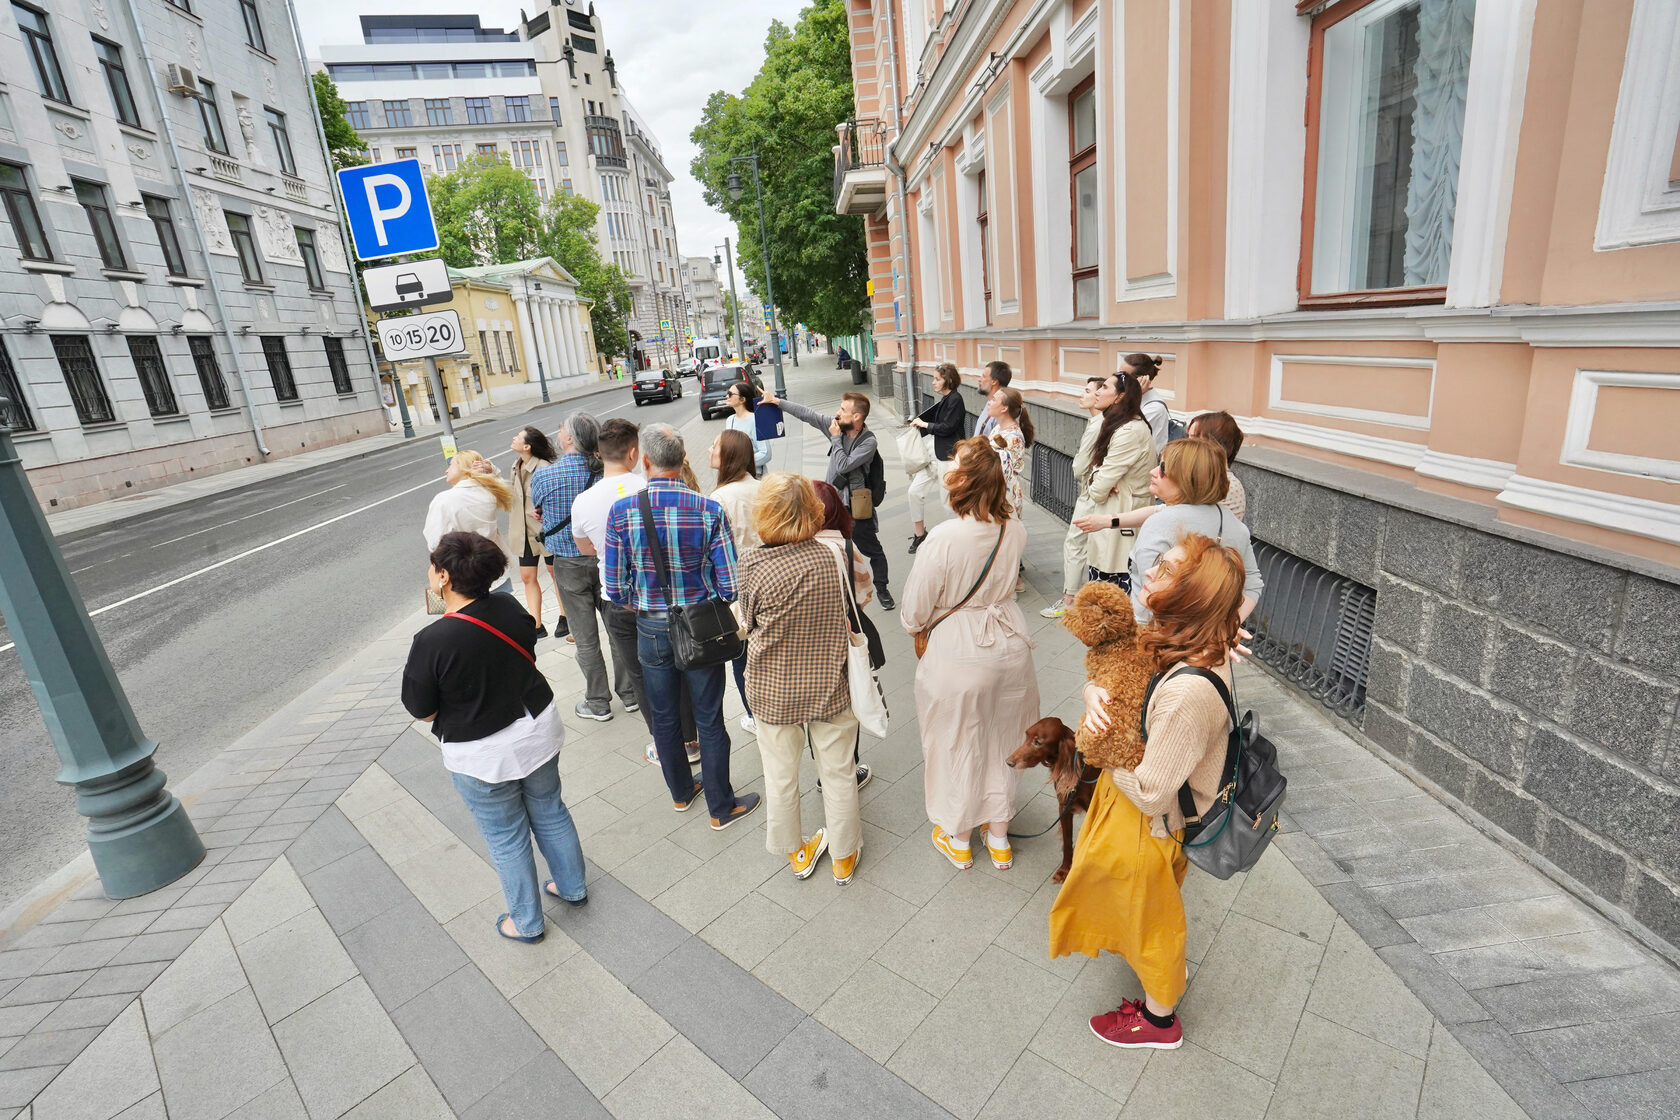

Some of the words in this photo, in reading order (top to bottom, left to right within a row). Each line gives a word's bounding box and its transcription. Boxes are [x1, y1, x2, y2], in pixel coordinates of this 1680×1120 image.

[363, 173, 412, 247] P
[389, 334, 403, 346] 10
[406, 329, 422, 345] 15
[427, 324, 451, 344] 20
